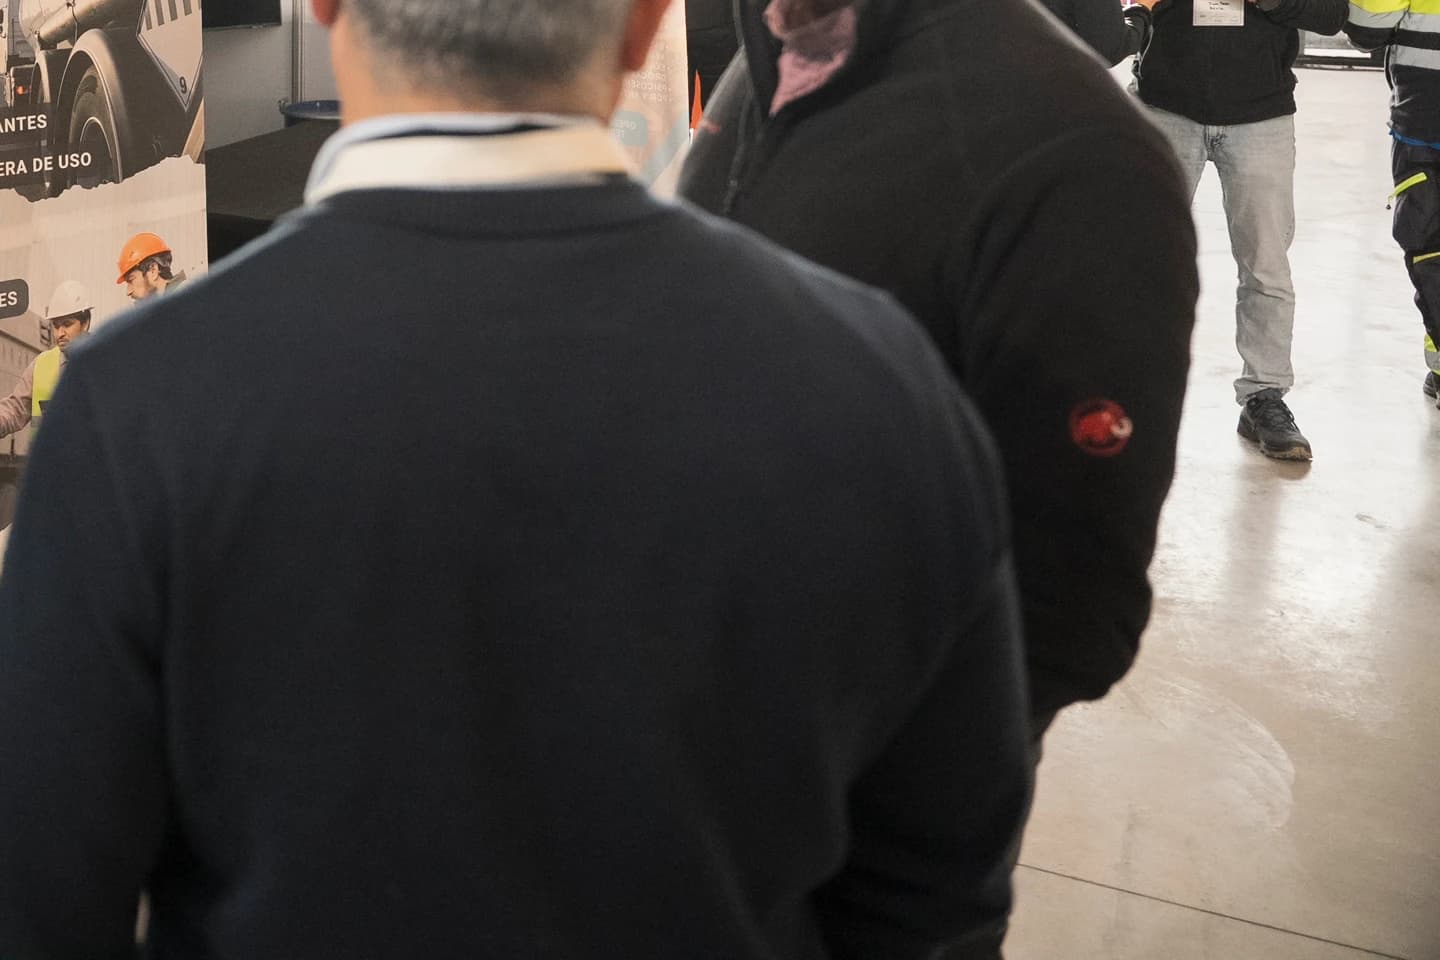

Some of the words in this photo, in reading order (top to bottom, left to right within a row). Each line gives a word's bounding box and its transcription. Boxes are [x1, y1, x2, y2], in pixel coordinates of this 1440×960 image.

[179, 76, 187, 94] 9
[32, 156, 54, 172] DE
[58, 151, 92, 169] USO
